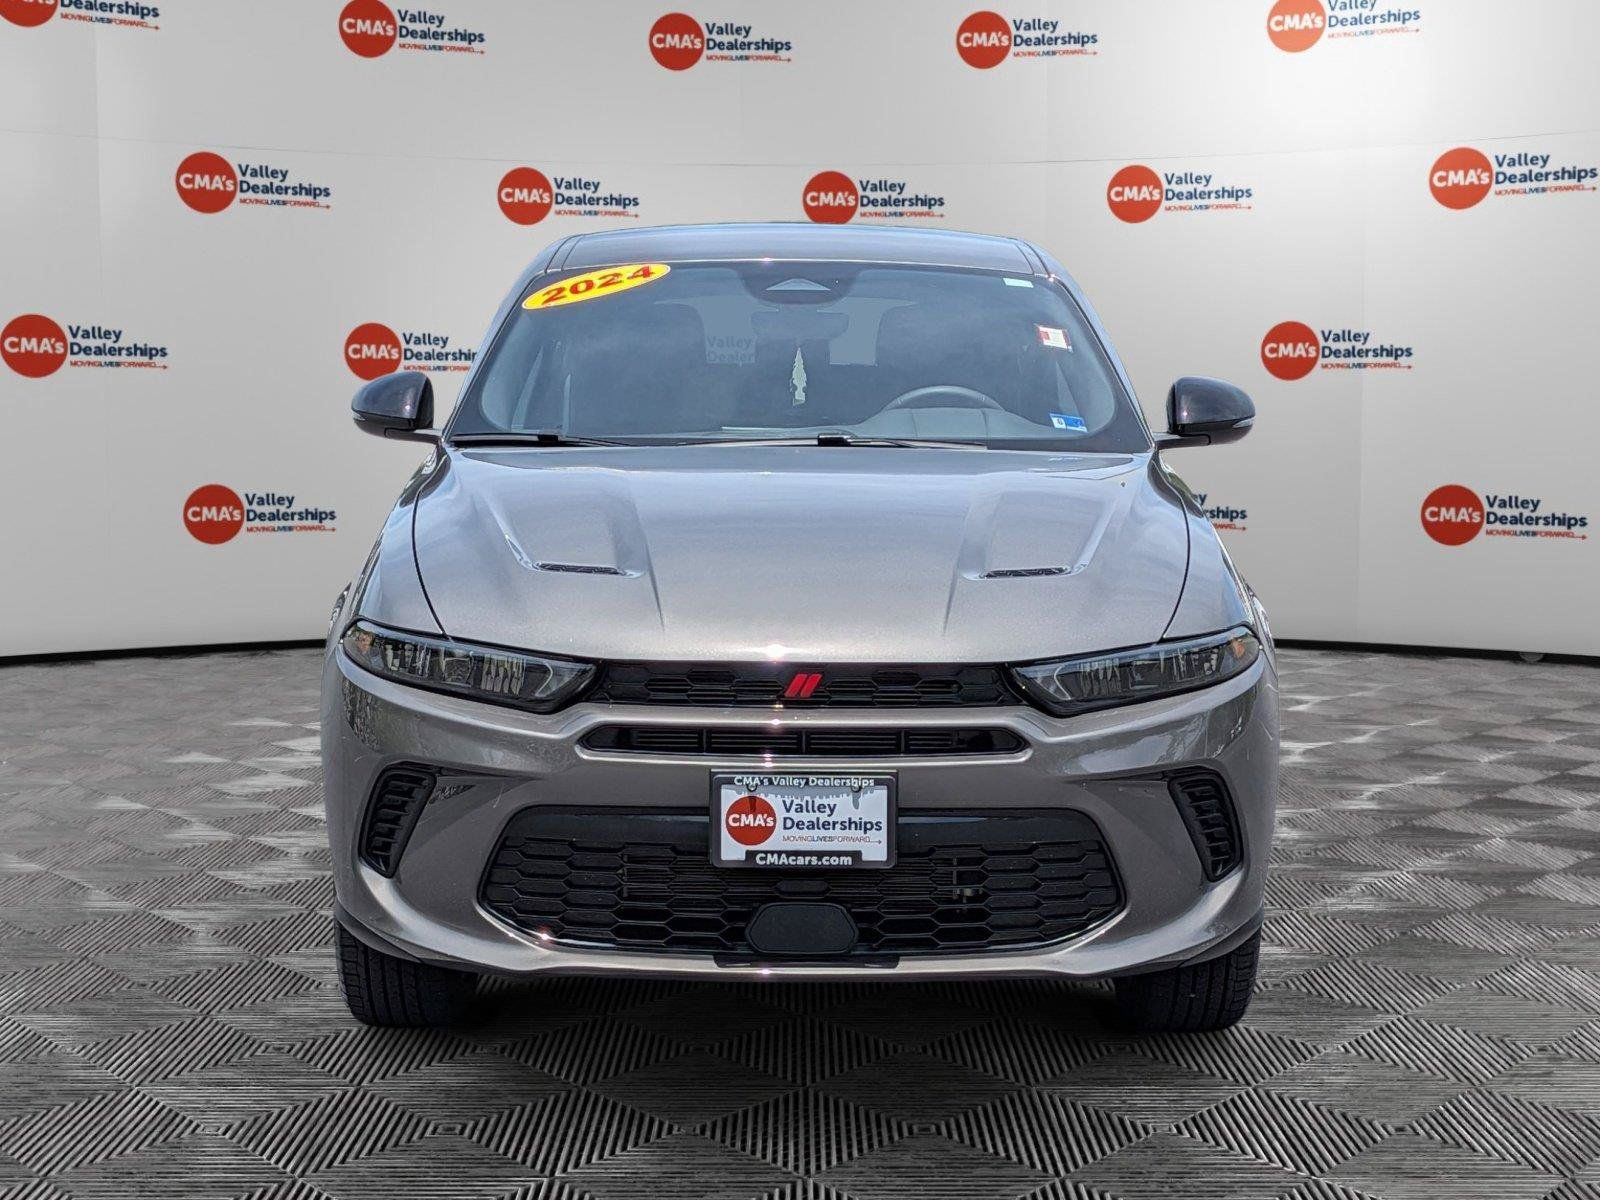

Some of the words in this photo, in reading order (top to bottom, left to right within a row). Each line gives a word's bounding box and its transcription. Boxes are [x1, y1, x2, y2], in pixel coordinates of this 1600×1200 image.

[60, 0, 160, 20] Dealerships
[1328, 0, 1377, 11] Valley
[397, 9, 445, 28] Valley
[1013, 19, 1059, 33] Valley
[1270, 12, 1324, 32] CMA's
[1328, 9, 1421, 28] Dealerships
[341, 18, 395, 36] CMA's
[399, 25, 486, 45] Dealerships
[705, 23, 752, 38] Valley
[652, 33, 702, 49] CMA's
[706, 38, 792, 53] Dealerships
[960, 31, 1010, 47] CMA's
[1013, 32, 1099, 47] Dealerships
[1495, 152, 1550, 168] Valley
[238, 164, 289, 182] Valley
[1164, 173, 1212, 187] Valley
[1432, 168, 1491, 188] CMA's
[1495, 166, 1599, 185] Dealerships
[179, 172, 235, 191] CMA's
[239, 180, 331, 199] Dealerships
[553, 177, 600, 193] Valley
[859, 180, 906, 195] Valley
[500, 187, 551, 204] CMA's
[555, 193, 640, 209] Dealerships
[806, 191, 856, 206] CMA's
[1110, 185, 1161, 202] CMA's
[1165, 186, 1253, 201] Dealerships
[860, 195, 945, 210] Dealerships
[541, 266, 655, 305] 2024
[68, 325, 122, 343] Valley
[403, 332, 449, 349] Valley
[1321, 330, 1370, 345] Valley
[3, 336, 65, 354] CMA's
[70, 341, 168, 360] Dealerships
[347, 343, 400, 360] CMA's
[1264, 342, 1318, 358] CMA's
[1321, 345, 1413, 360] Dealerships
[404, 348, 477, 361] Dealershi
[245, 493, 295, 509] Valley
[1485, 495, 1540, 513] Valley
[187, 505, 242, 522] CMA's
[246, 508, 337, 524] Dealerships
[1425, 506, 1481, 523] CMA's
[1486, 511, 1588, 530] Dealerships
[734, 776, 769, 786] CMA's
[772, 776, 807, 788] Valley
[808, 776, 875, 787] Dealerships
[782, 800, 837, 816] Valley
[728, 814, 774, 827] CMA's
[782, 817, 883, 834] Dealerships
[755, 853, 853, 866] CMAcars.com
